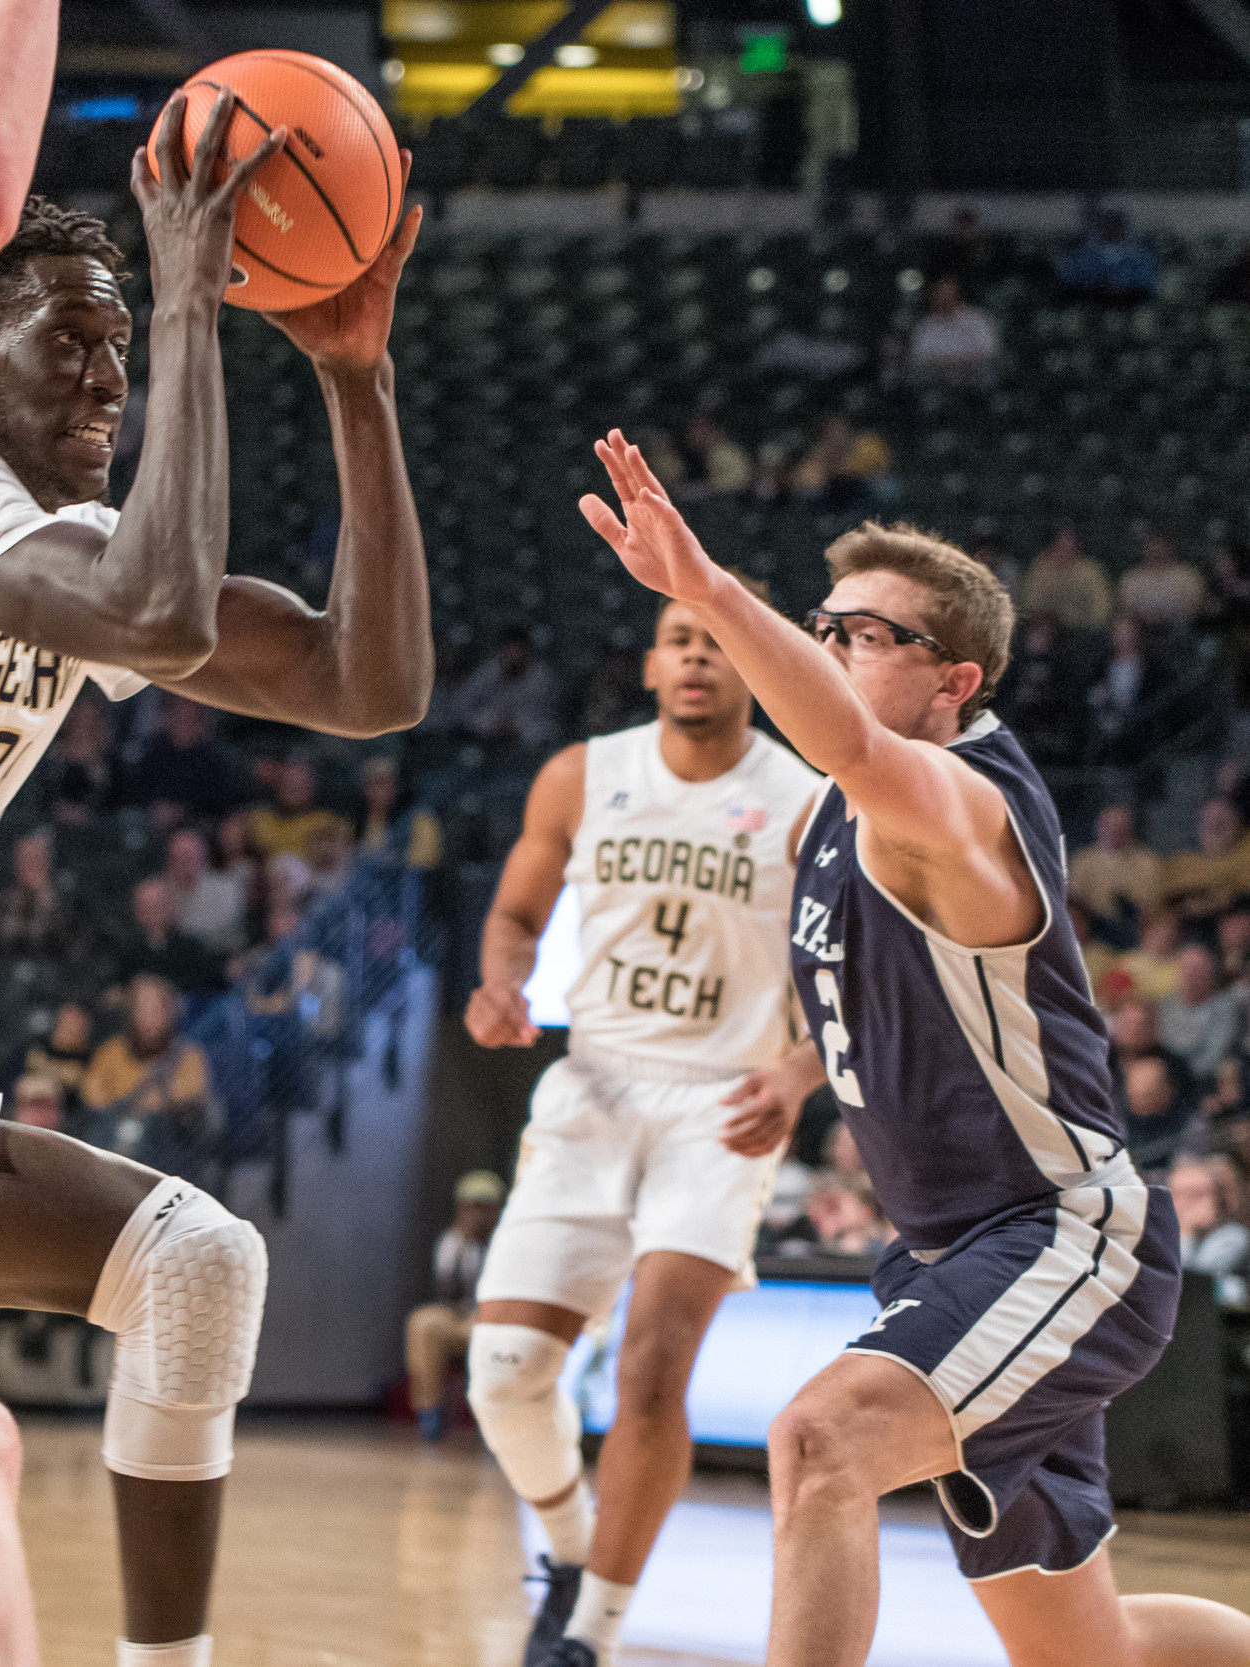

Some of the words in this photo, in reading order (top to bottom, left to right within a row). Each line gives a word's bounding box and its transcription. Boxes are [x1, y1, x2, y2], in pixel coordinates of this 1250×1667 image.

[595, 838, 754, 904] GEORGIA
[654, 901, 687, 955] 4
[607, 956, 724, 1018] TECH
[814, 968, 866, 1108] 2
